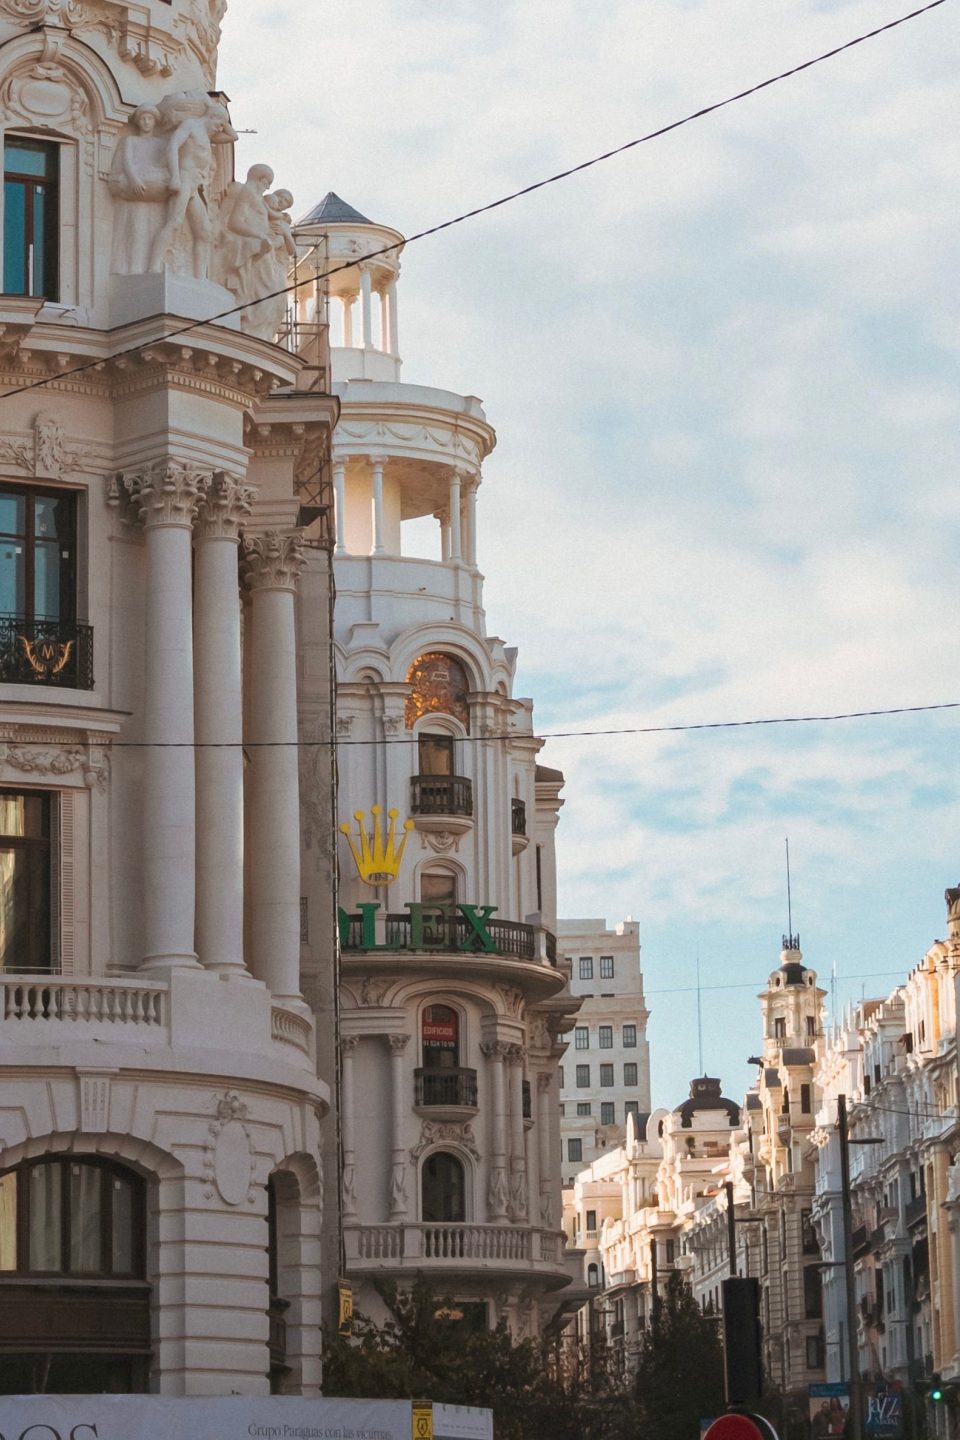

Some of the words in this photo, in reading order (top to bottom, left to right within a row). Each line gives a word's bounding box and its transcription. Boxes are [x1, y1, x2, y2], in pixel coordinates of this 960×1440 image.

[248, 1423, 281, 1440] Grupo
[283, 1424, 323, 1440] Paraguas
[325, 1428, 341, 1438] con
[343, 1425, 354, 1439] las
